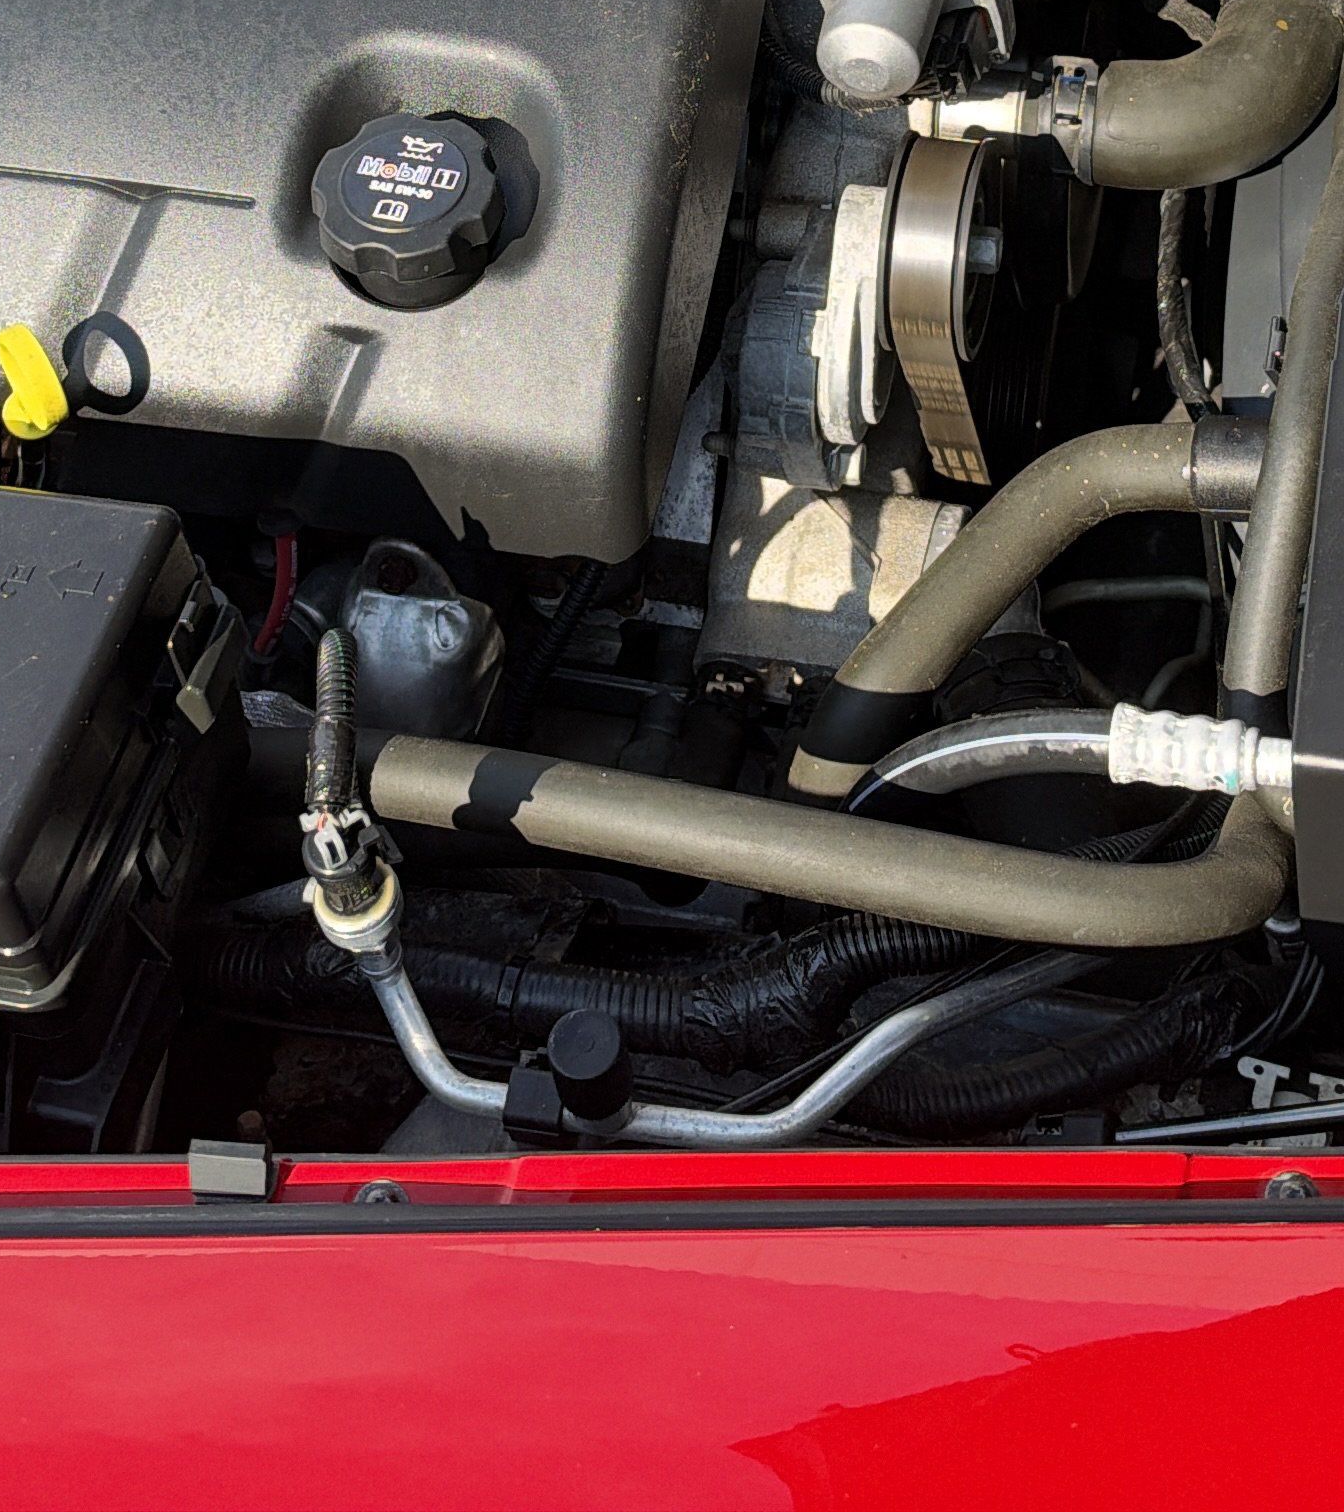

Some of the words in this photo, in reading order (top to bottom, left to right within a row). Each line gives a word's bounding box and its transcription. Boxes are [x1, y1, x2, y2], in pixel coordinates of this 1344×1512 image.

[357, 156, 432, 185] Mobil
[369, 180, 393, 194] SAE
[395, 186, 434, 200] 5W-30
